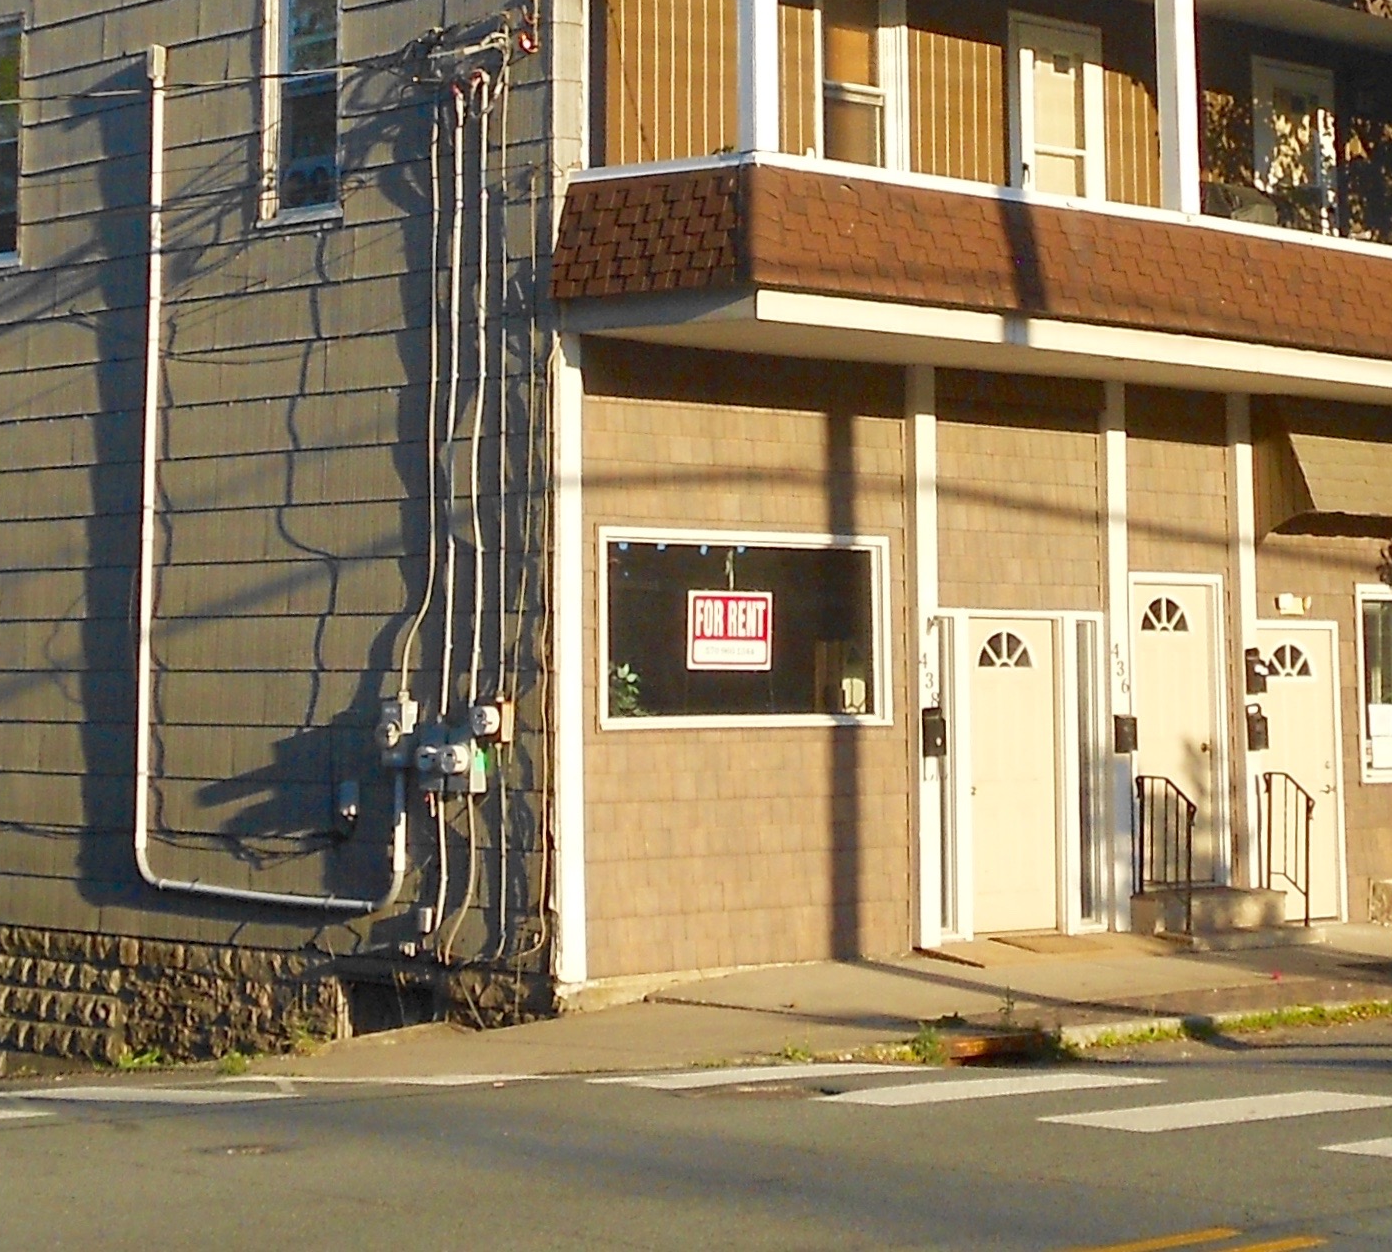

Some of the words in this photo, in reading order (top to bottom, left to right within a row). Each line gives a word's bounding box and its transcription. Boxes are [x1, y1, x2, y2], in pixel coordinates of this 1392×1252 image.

[695, 599, 724, 637] FOR
[727, 599, 767, 638] RENT
[1111, 643, 1130, 694] 436
